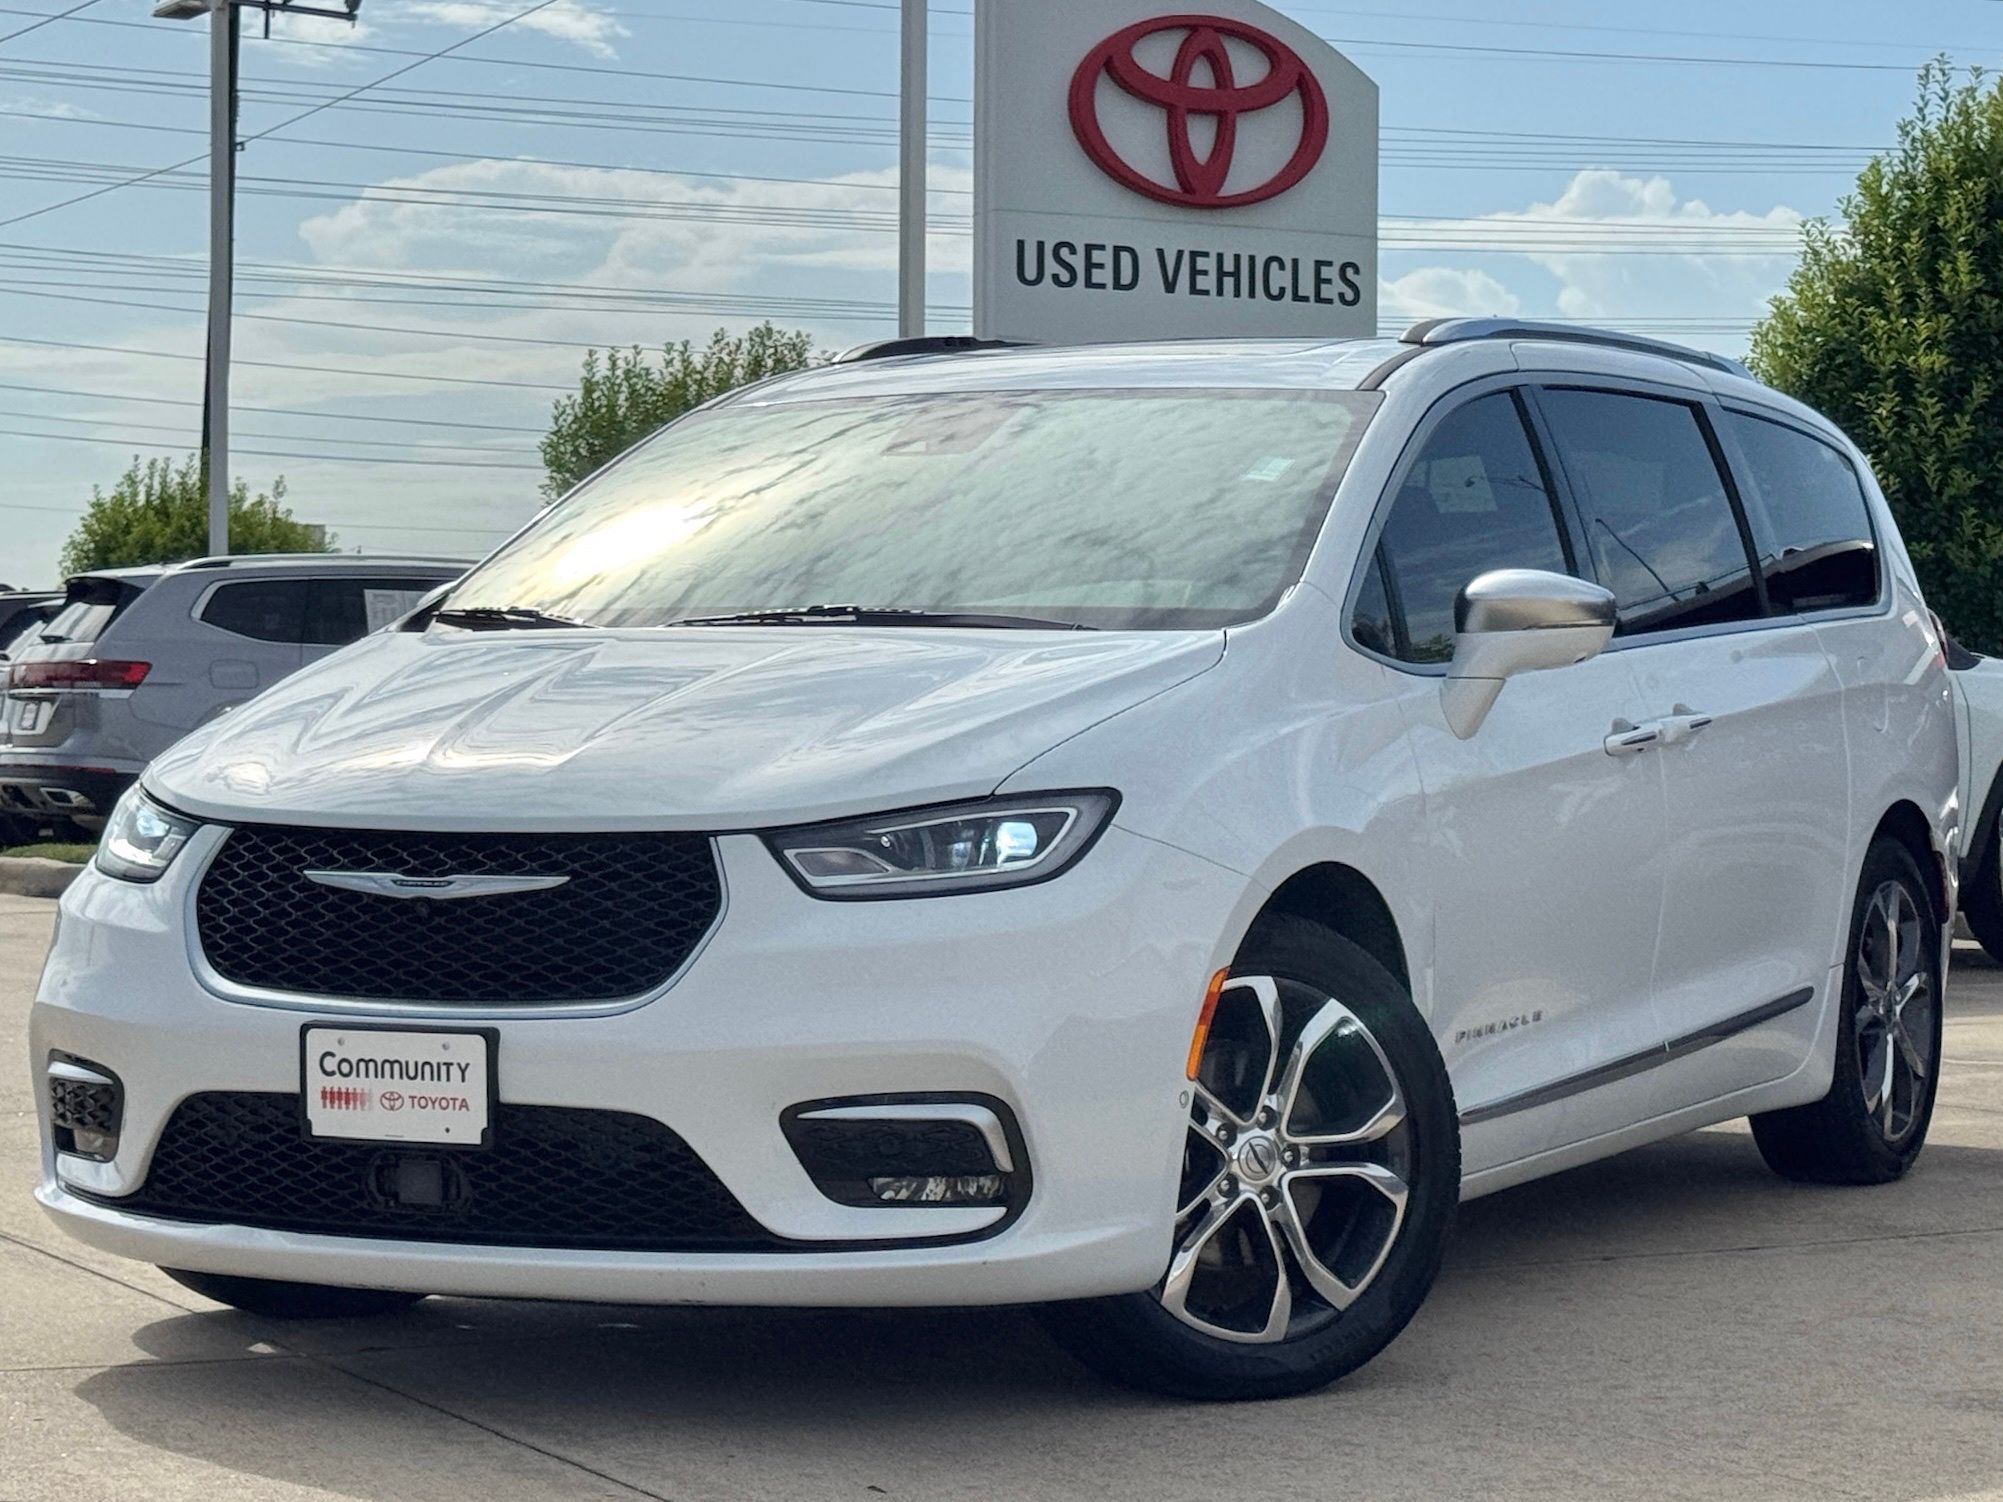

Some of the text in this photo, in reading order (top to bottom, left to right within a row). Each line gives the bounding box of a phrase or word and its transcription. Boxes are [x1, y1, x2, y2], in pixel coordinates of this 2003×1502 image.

[1015, 239, 1362, 307] USED VEHICLES
[408, 1095, 471, 1112] TOYOTA
